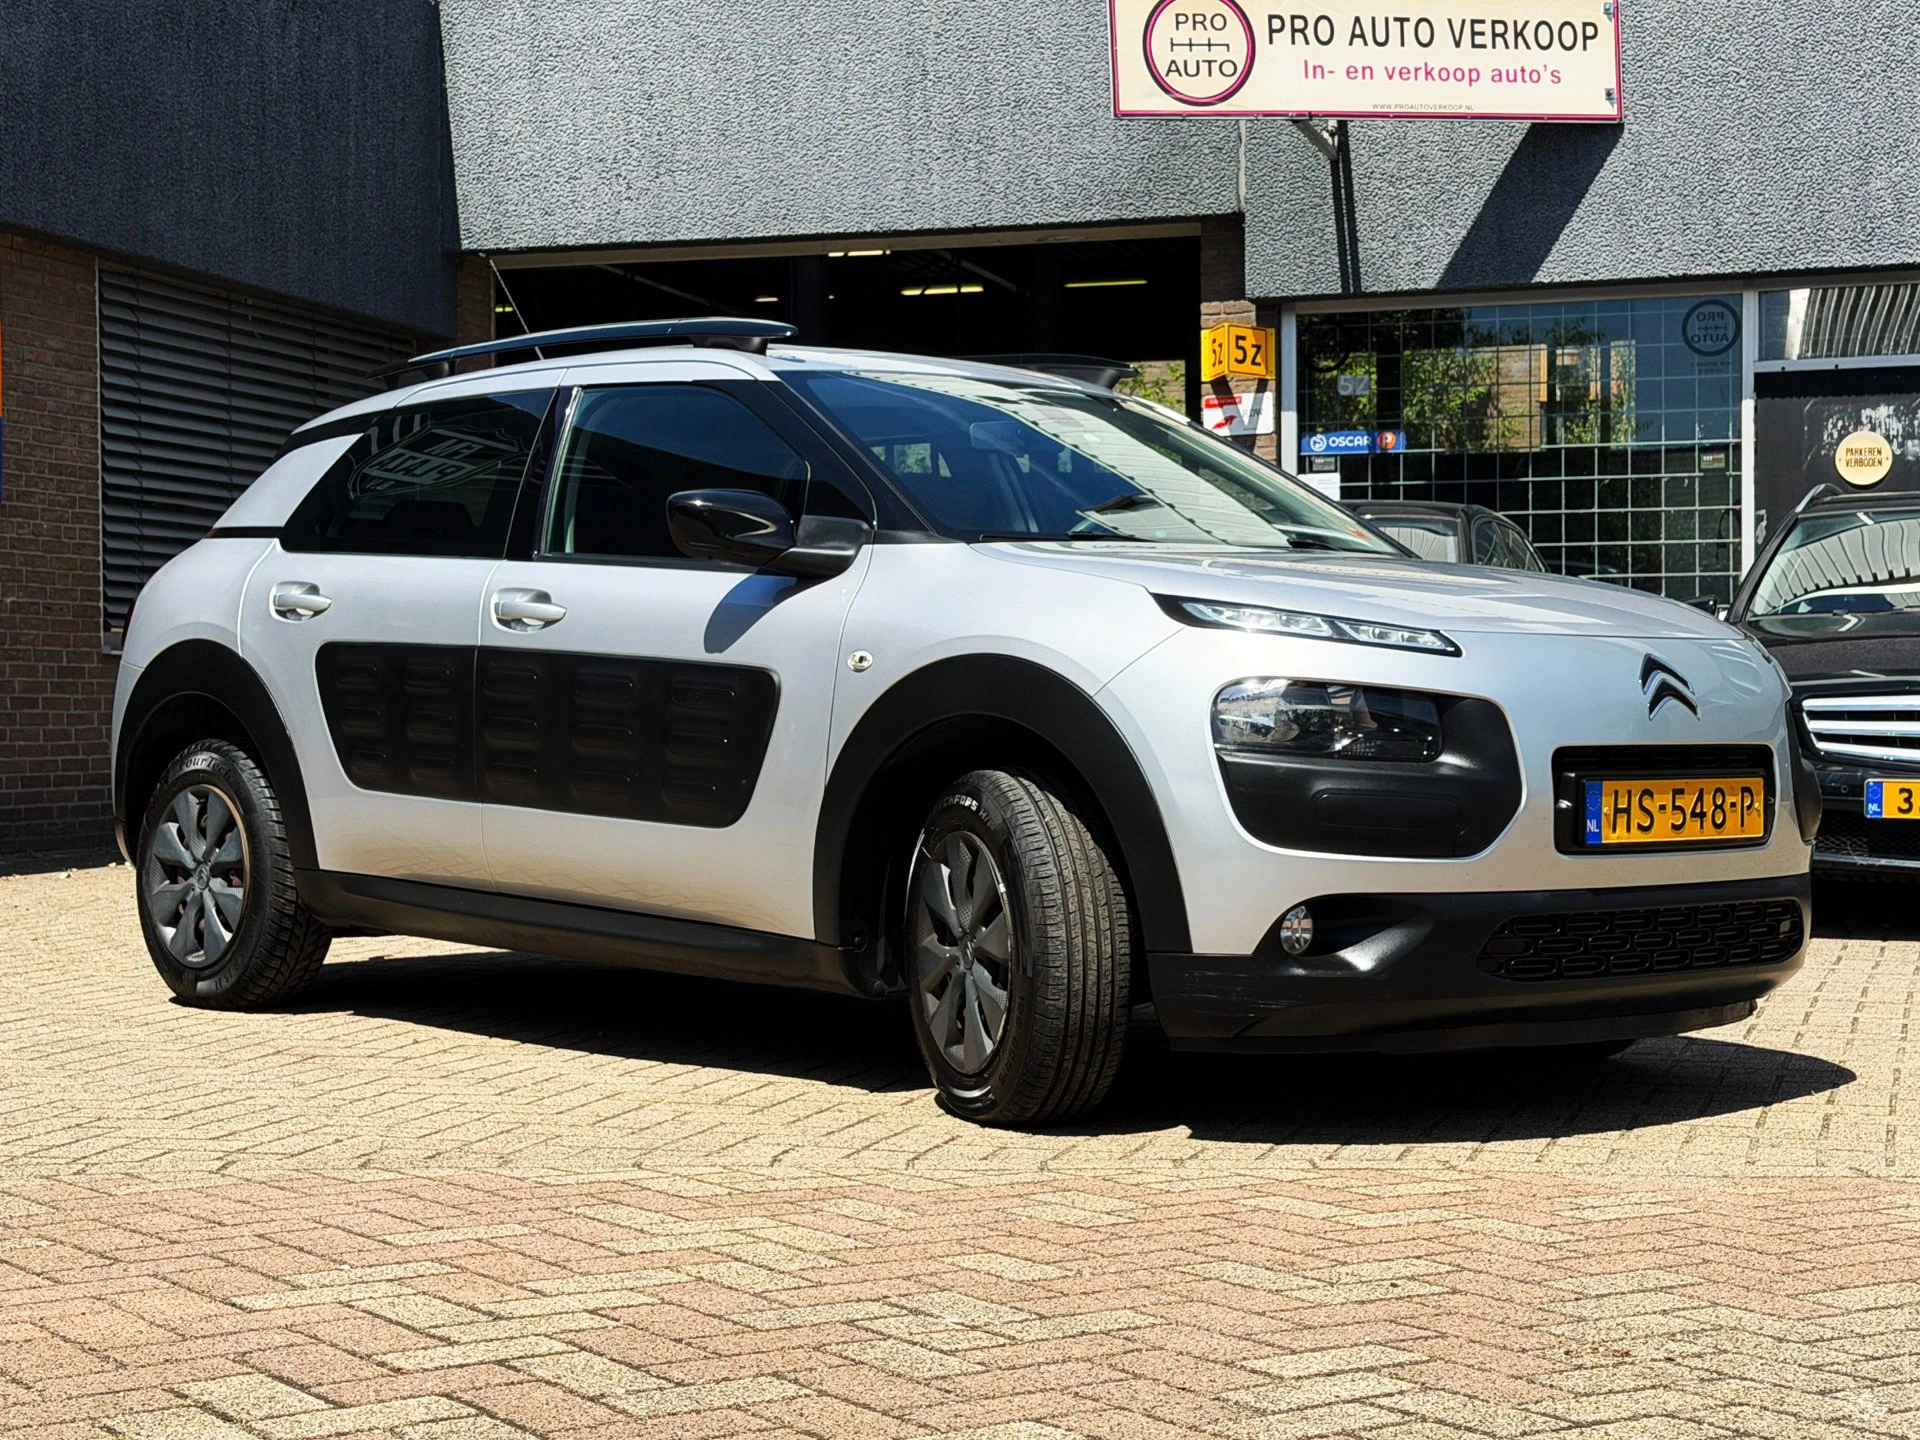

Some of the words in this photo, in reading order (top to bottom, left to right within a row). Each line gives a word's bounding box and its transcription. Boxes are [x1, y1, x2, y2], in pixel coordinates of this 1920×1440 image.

[1175, 13, 1227, 31] PRO
[1268, 14, 1335, 46] PRO
[1348, 16, 1435, 48] AUTO
[1447, 18, 1599, 51] VERKOOP
[1165, 59, 1238, 77] AUTO
[1304, 59, 1336, 80] In-
[1345, 64, 1374, 81] en
[1384, 62, 1481, 87] verkoop
[1490, 64, 1562, 84] auto's
[1328, 436, 1372, 447] OSCAR
[1845, 447, 1883, 457] PARKEREN
[1845, 457, 1883, 468] VERBODEN
[1610, 786, 1755, 834] HS-548-P
[1868, 803, 1881, 814] NL
[1587, 819, 1600, 832] NL
